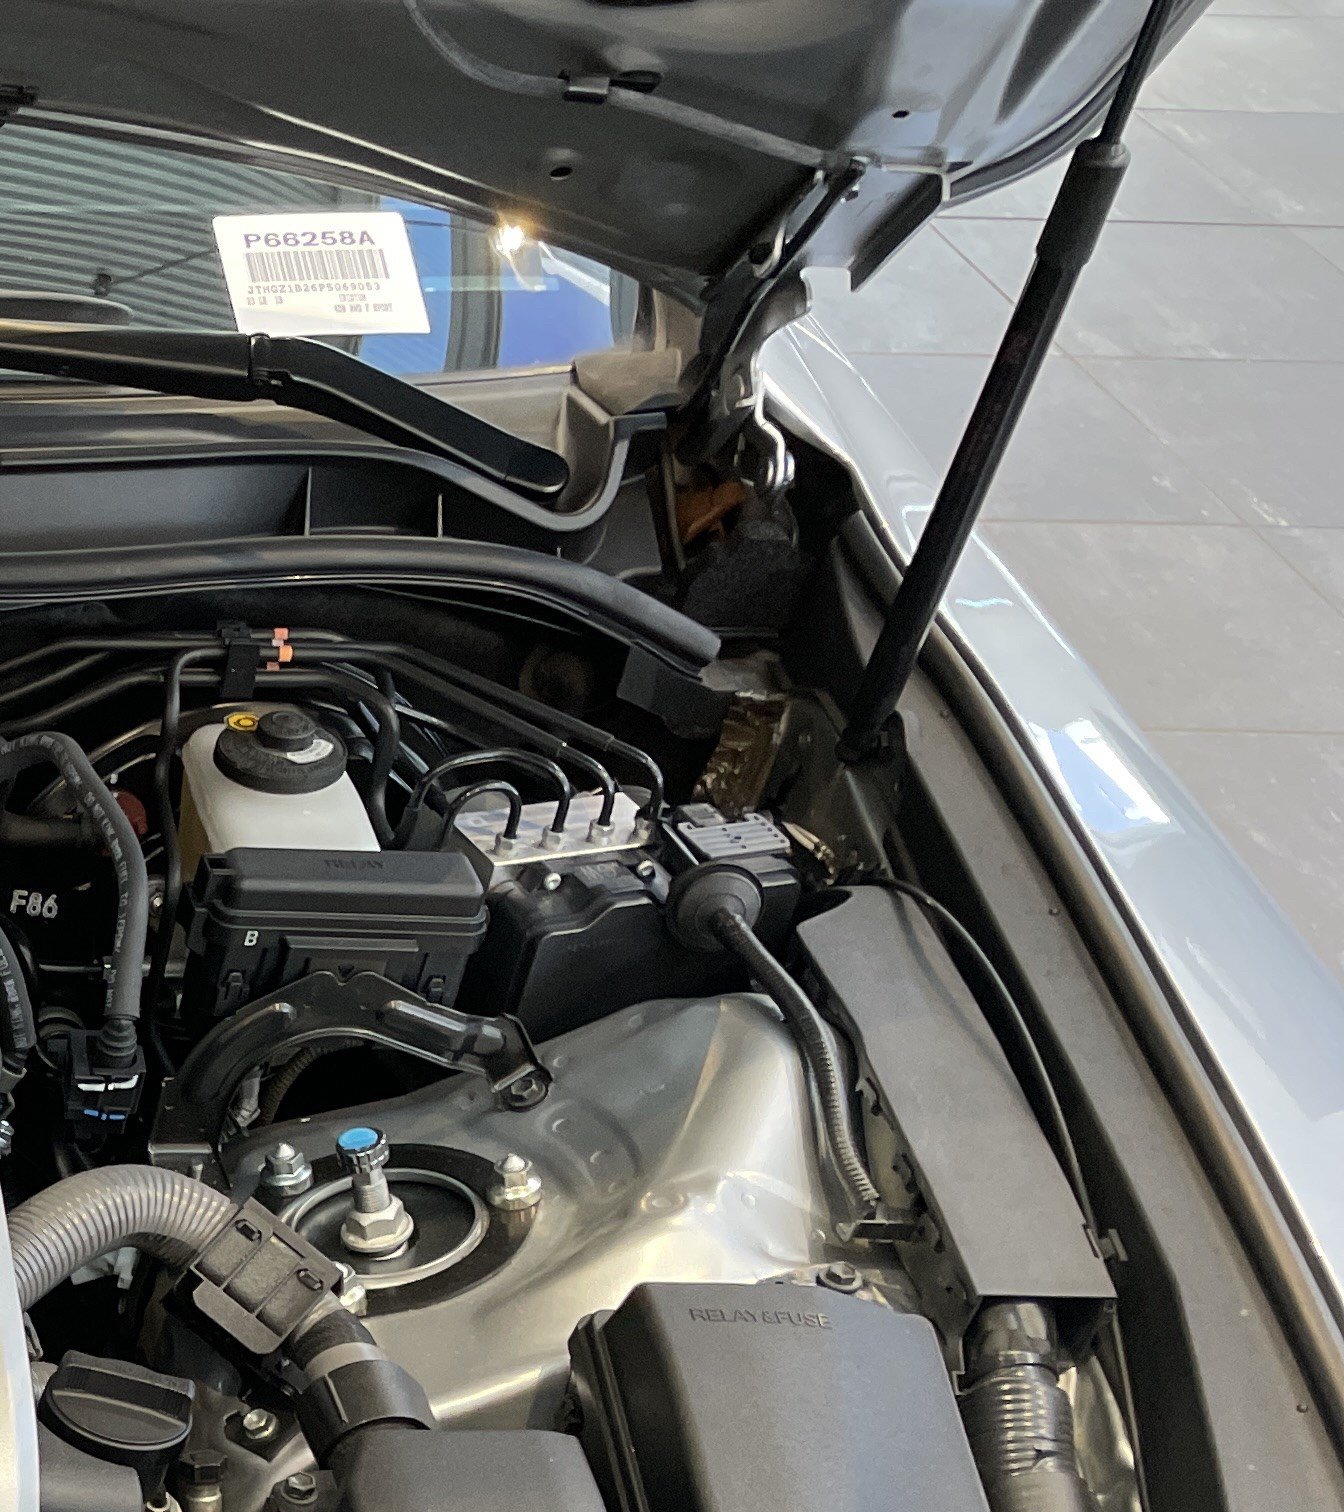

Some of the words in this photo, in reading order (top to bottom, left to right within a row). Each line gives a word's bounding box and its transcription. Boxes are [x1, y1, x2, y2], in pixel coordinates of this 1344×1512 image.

[243, 230, 376, 249] P66258A
[10, 889, 59, 919] F86
[243, 929, 260, 947] B
[688, 1307, 833, 1331] RELAY&FUSE
